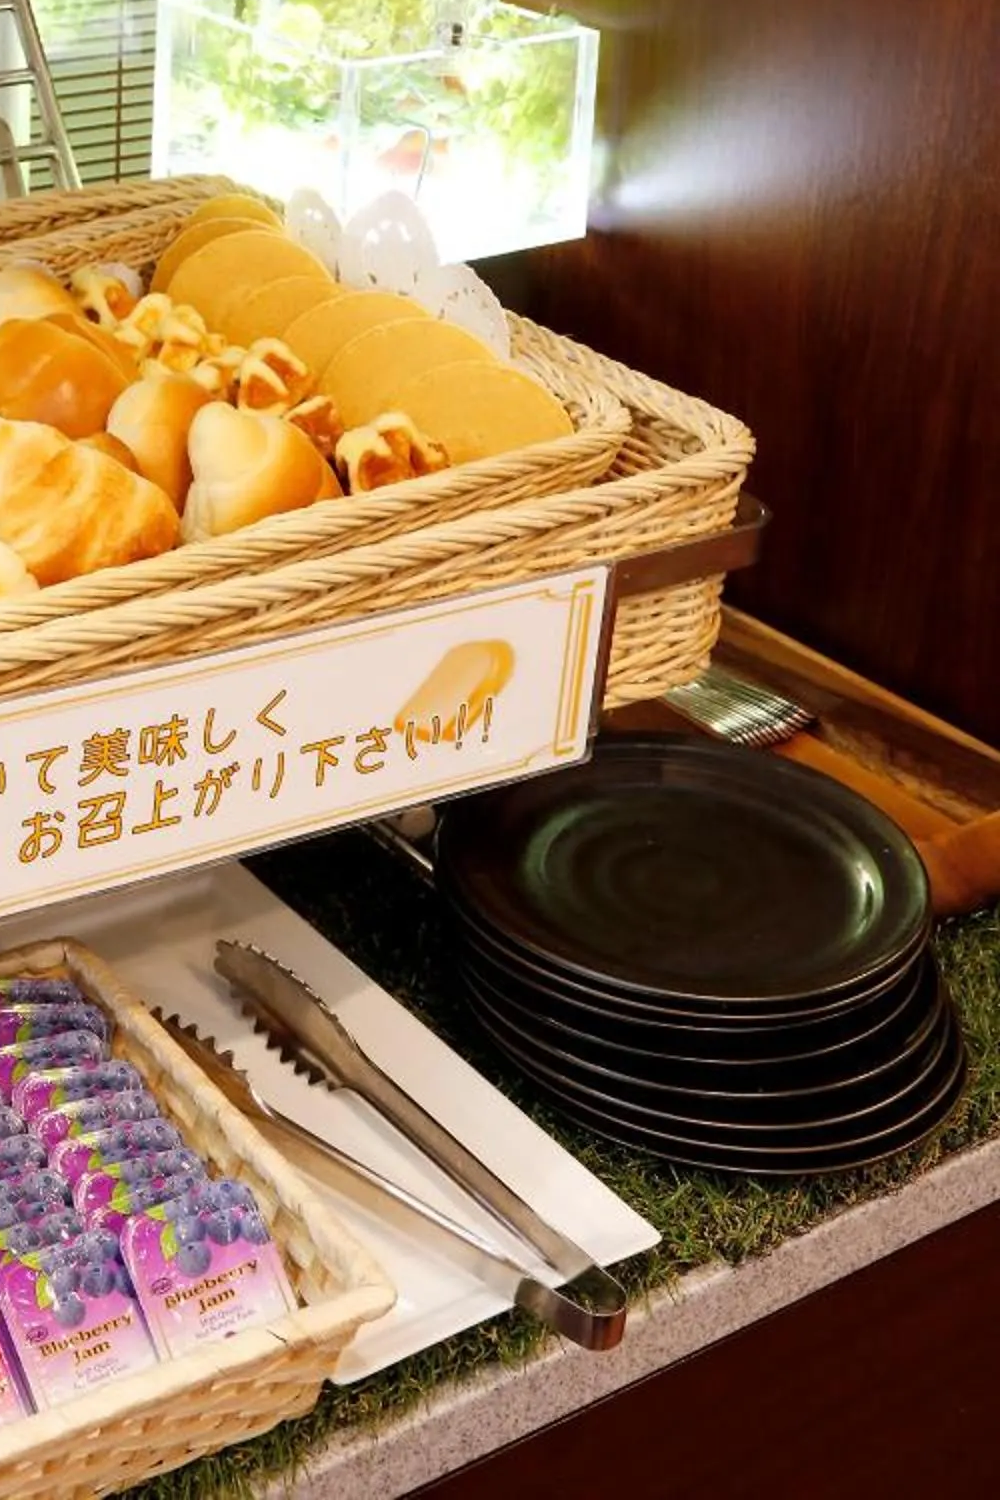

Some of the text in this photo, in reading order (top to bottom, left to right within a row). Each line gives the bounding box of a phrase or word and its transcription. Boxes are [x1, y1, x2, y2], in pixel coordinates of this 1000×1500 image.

[163, 1258, 258, 1311] Blueberry
[199, 1287, 237, 1315] Jam
[38, 1314, 133, 1359] Blueberry
[73, 1340, 112, 1367] Jam
